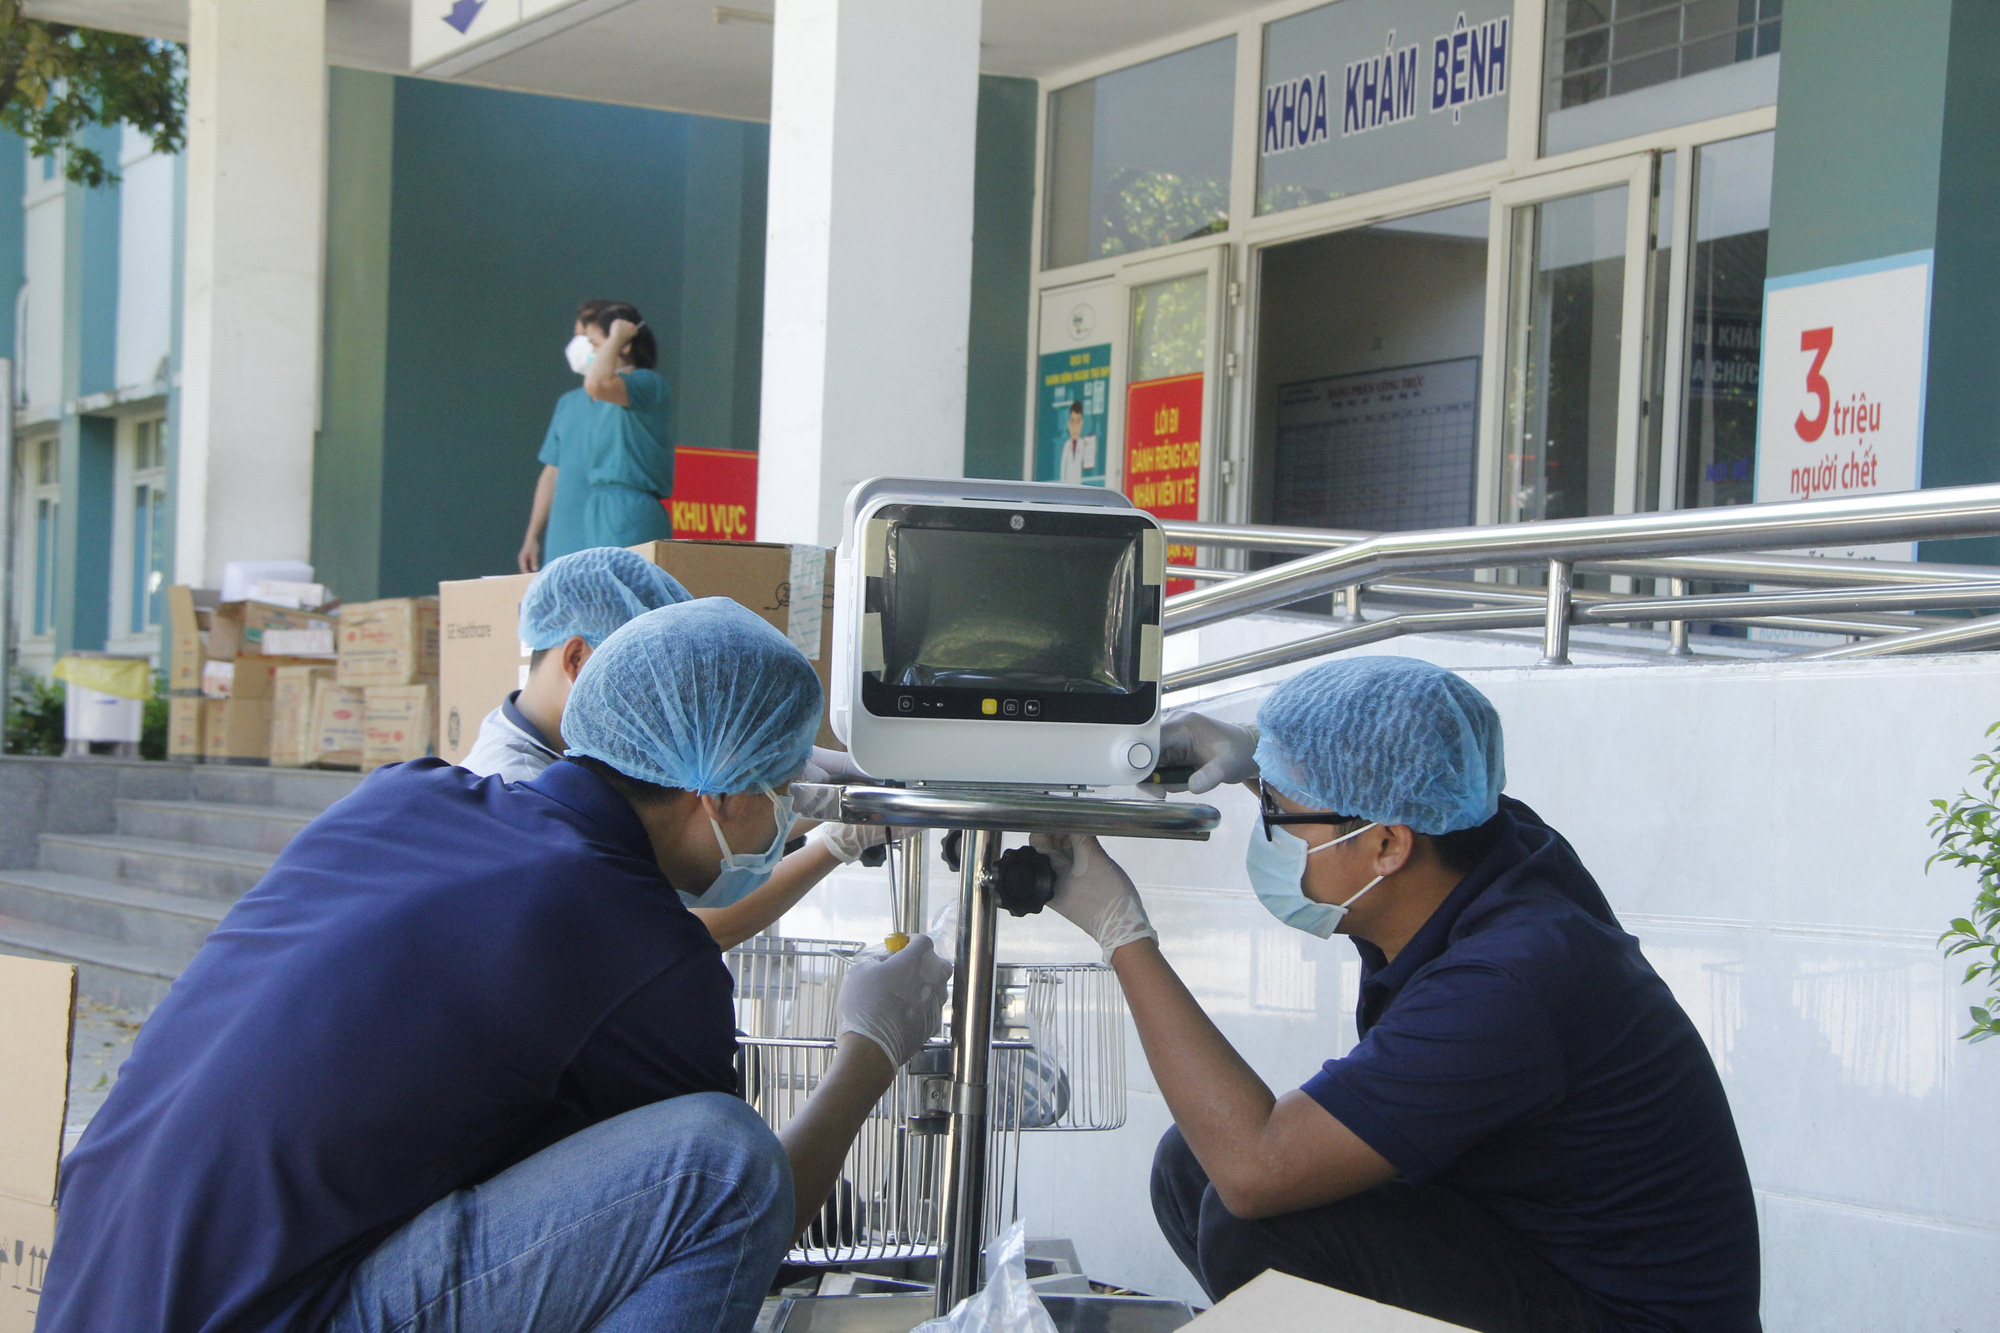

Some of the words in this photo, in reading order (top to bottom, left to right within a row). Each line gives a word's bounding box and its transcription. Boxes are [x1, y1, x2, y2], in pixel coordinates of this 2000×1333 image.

[1263, 71, 1328, 156] KHOA
[1344, 30, 1418, 137] KHÁM
[1430, 12, 1510, 125] BỆNH
[1794, 326, 1834, 443] 3
[1834, 393, 1880, 447] triệu
[1155, 438, 1180, 471] RIÊNG
[1181, 441, 1200, 468] CHO
[1790, 450, 1837, 500] người
[1841, 445, 1878, 490] chết
[1133, 476, 1156, 508] NHÂN
[1157, 473, 1176, 506] VIÊN
[1177, 479, 1183, 504] Y
[1184, 472, 1195, 503] TẾ
[672, 501, 708, 533] KHU
[711, 502, 747, 540] VỰC
[457, 619, 491, 639] Healthcare
